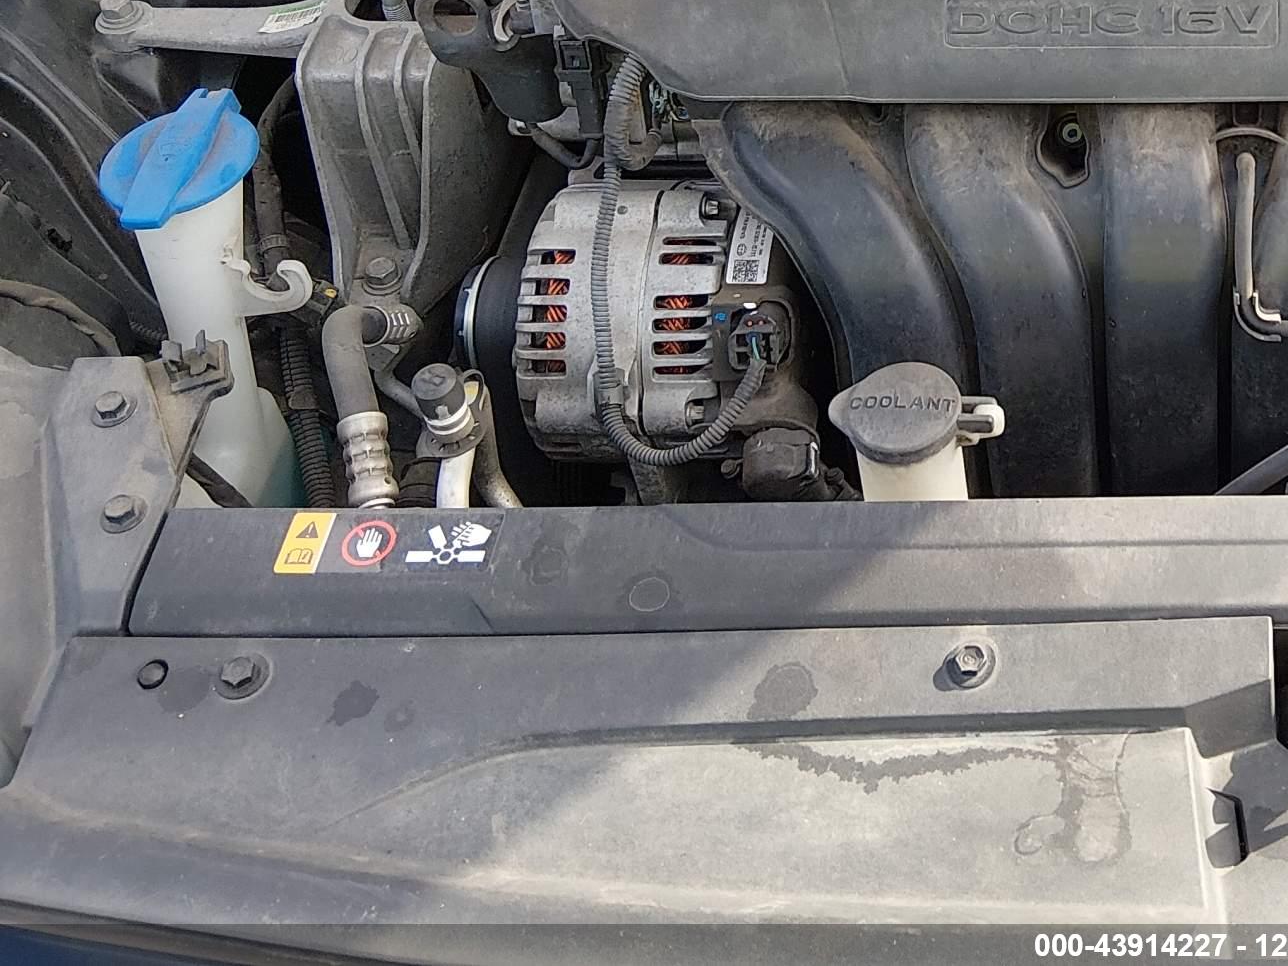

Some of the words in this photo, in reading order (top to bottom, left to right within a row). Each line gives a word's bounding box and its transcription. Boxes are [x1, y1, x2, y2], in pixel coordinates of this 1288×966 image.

[951, 4, 1142, 35] DOHC
[1158, 3, 1272, 35] 16V
[849, 395, 956, 413] COOLANT
